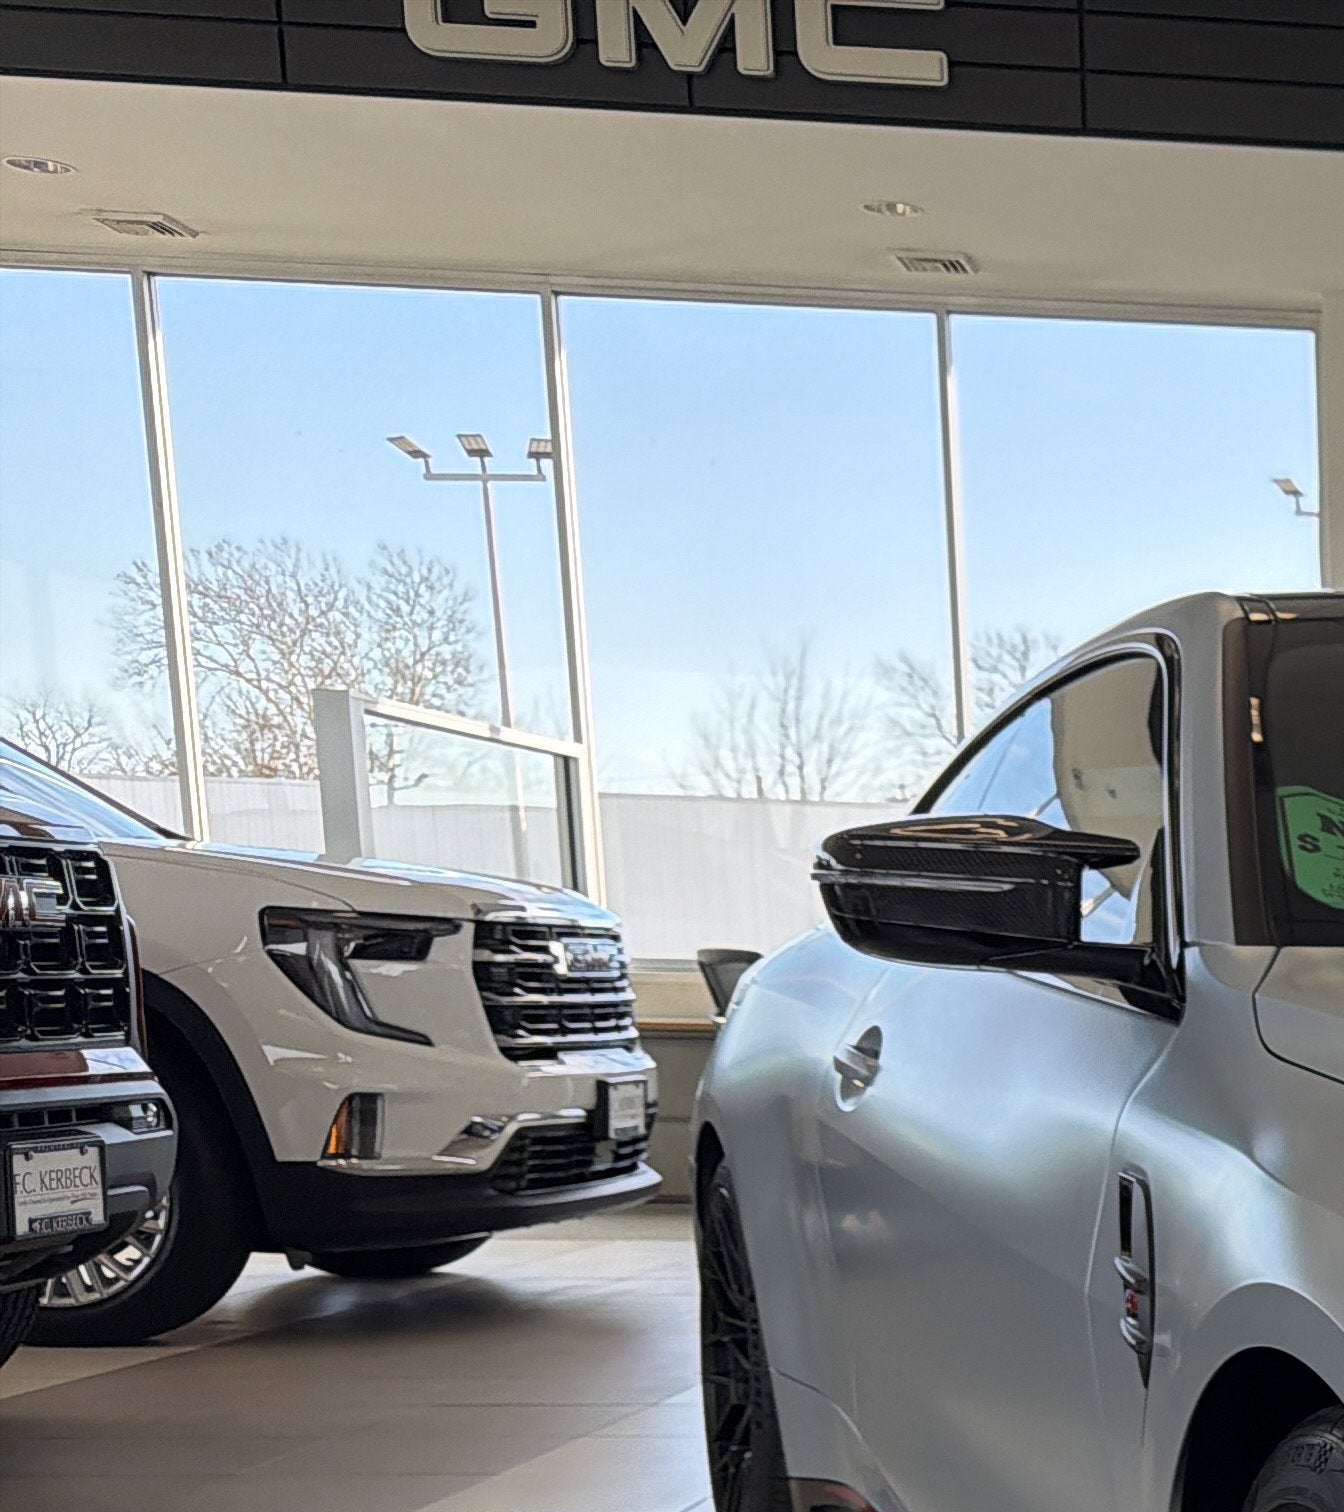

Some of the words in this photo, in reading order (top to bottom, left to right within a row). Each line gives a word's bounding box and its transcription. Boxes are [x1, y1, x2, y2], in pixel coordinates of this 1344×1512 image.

[13, 1171, 36, 1195] F.C.
[39, 1165, 99, 1192] KERBECK
[52, 1213, 90, 1233] KERBECK
